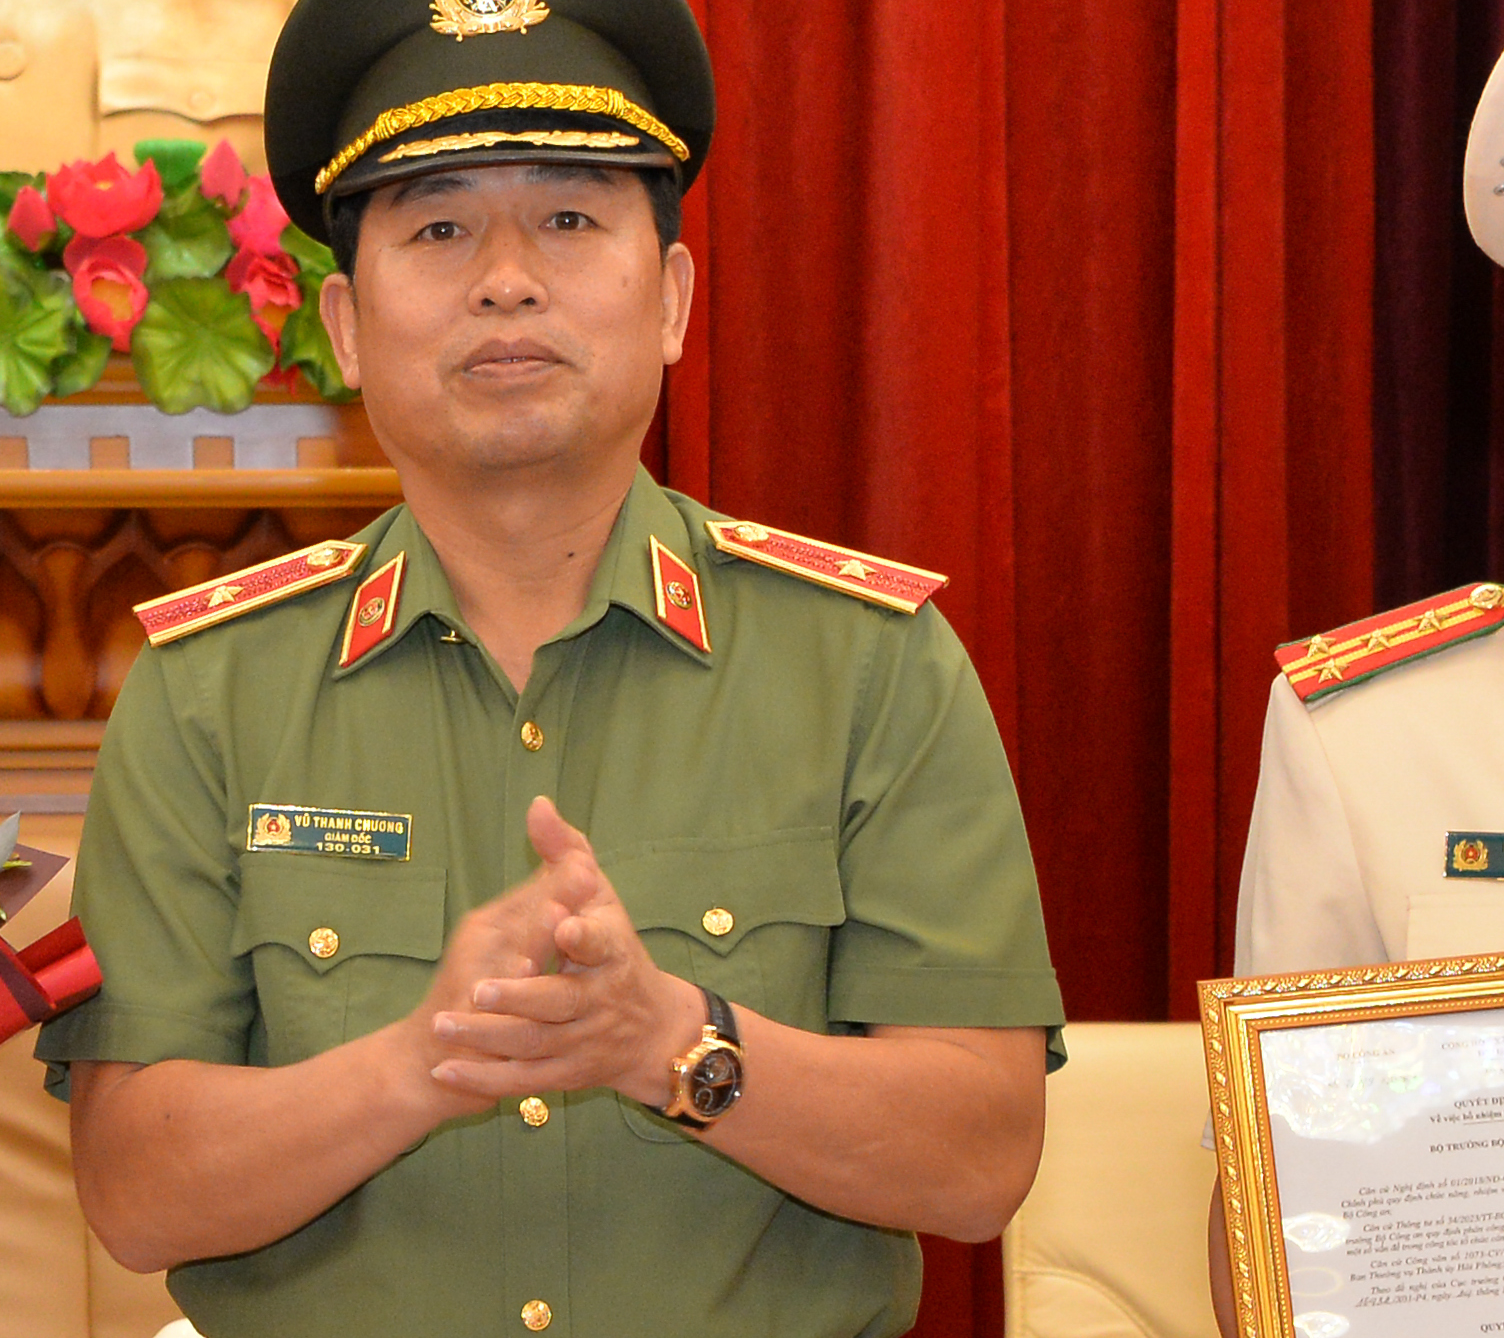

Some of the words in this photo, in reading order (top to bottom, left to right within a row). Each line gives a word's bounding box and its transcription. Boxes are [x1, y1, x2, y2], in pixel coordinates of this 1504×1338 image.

[294, 813, 310, 827] VŨ
[313, 816, 352, 830] THANH
[324, 831, 350, 843] GIÁM
[1452, 1096, 1490, 1109] QUYẾT
[1428, 1143, 1445, 1154] BỘ
[1444, 1138, 1490, 1152] TRƯỞNG
